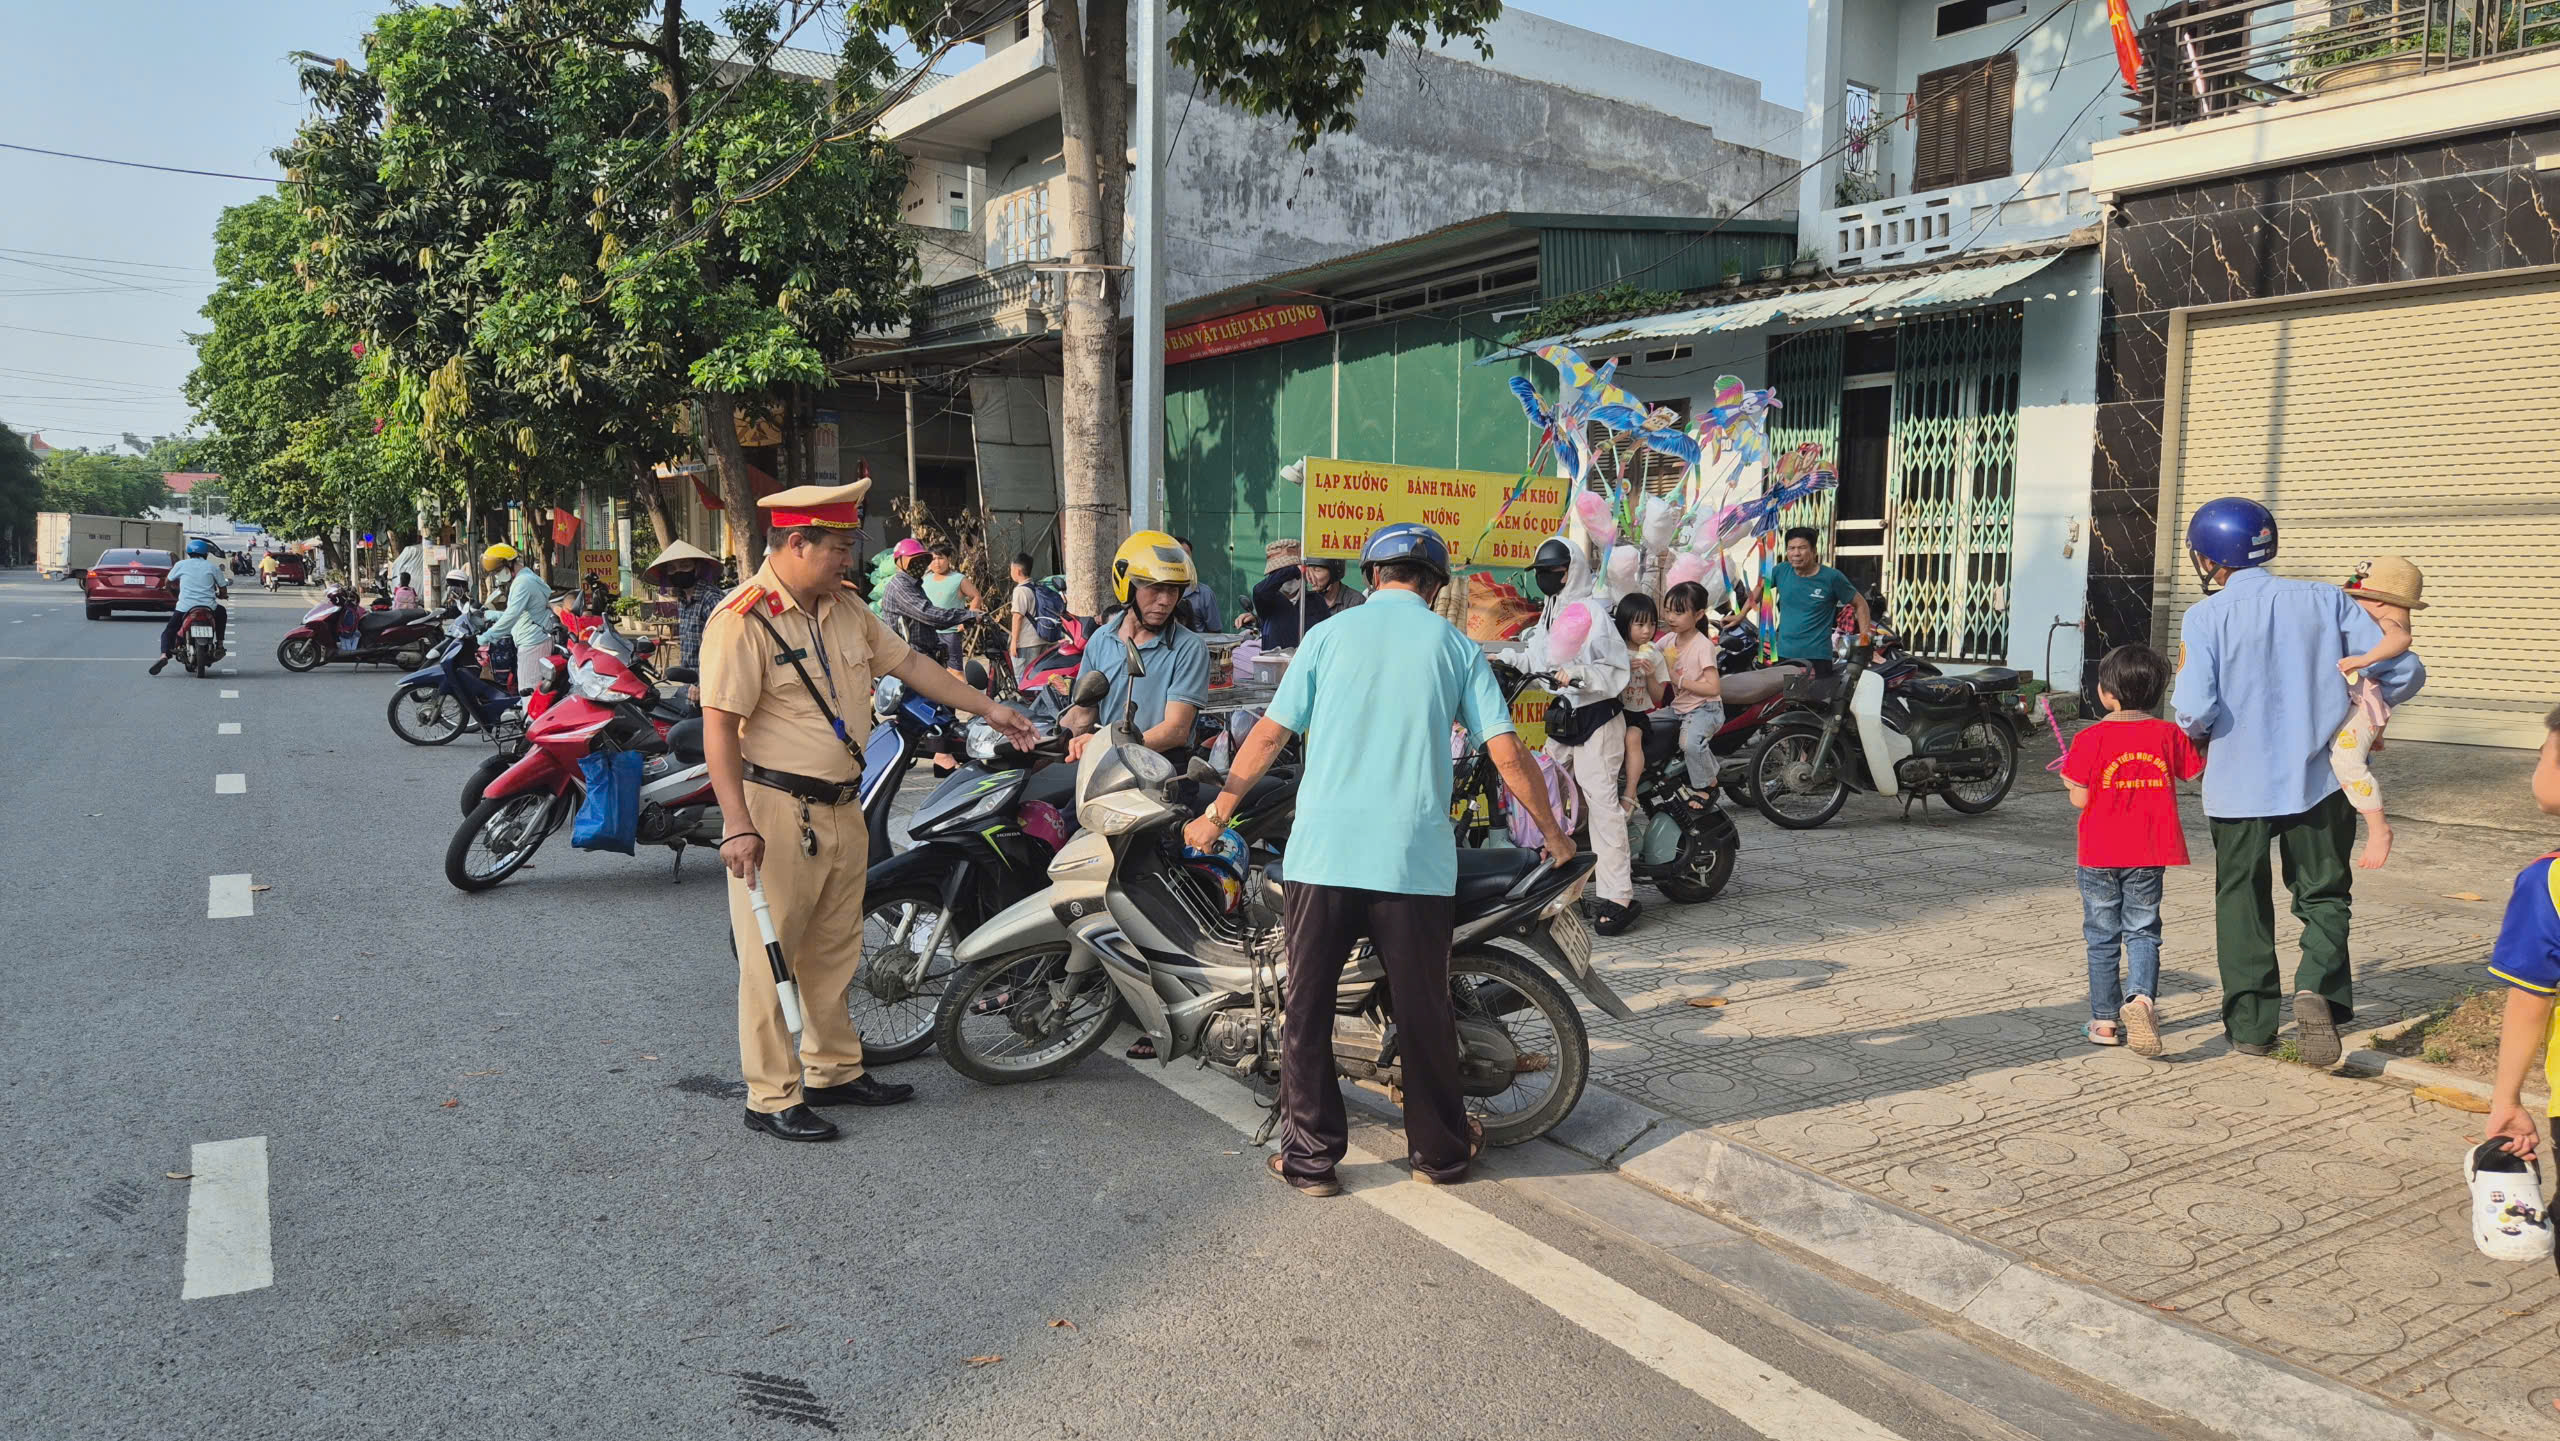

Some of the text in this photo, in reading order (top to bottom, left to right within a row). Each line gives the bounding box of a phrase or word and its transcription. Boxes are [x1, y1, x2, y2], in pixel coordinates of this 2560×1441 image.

[1194, 325, 1219, 346] VẬT
[1220, 319, 1248, 340] LIỆU
[1249, 312, 1275, 332] XÂY
[1279, 304, 1317, 327] DỰNG
[1315, 470, 1389, 492] LẠP XƯỞNG
[1407, 476, 1476, 498] BÁNH TRÁNG
[1530, 487, 1559, 504] KHÓI
[1318, 501, 1385, 521] NƯỚNG ĐÁ
[1422, 507, 1460, 526] NƯỚNG
[1523, 510, 1538, 531] ỐC
[1321, 530, 1340, 549] HÀ
[1493, 539, 1508, 557] BÒ
[1511, 540, 1531, 559] BÍA
